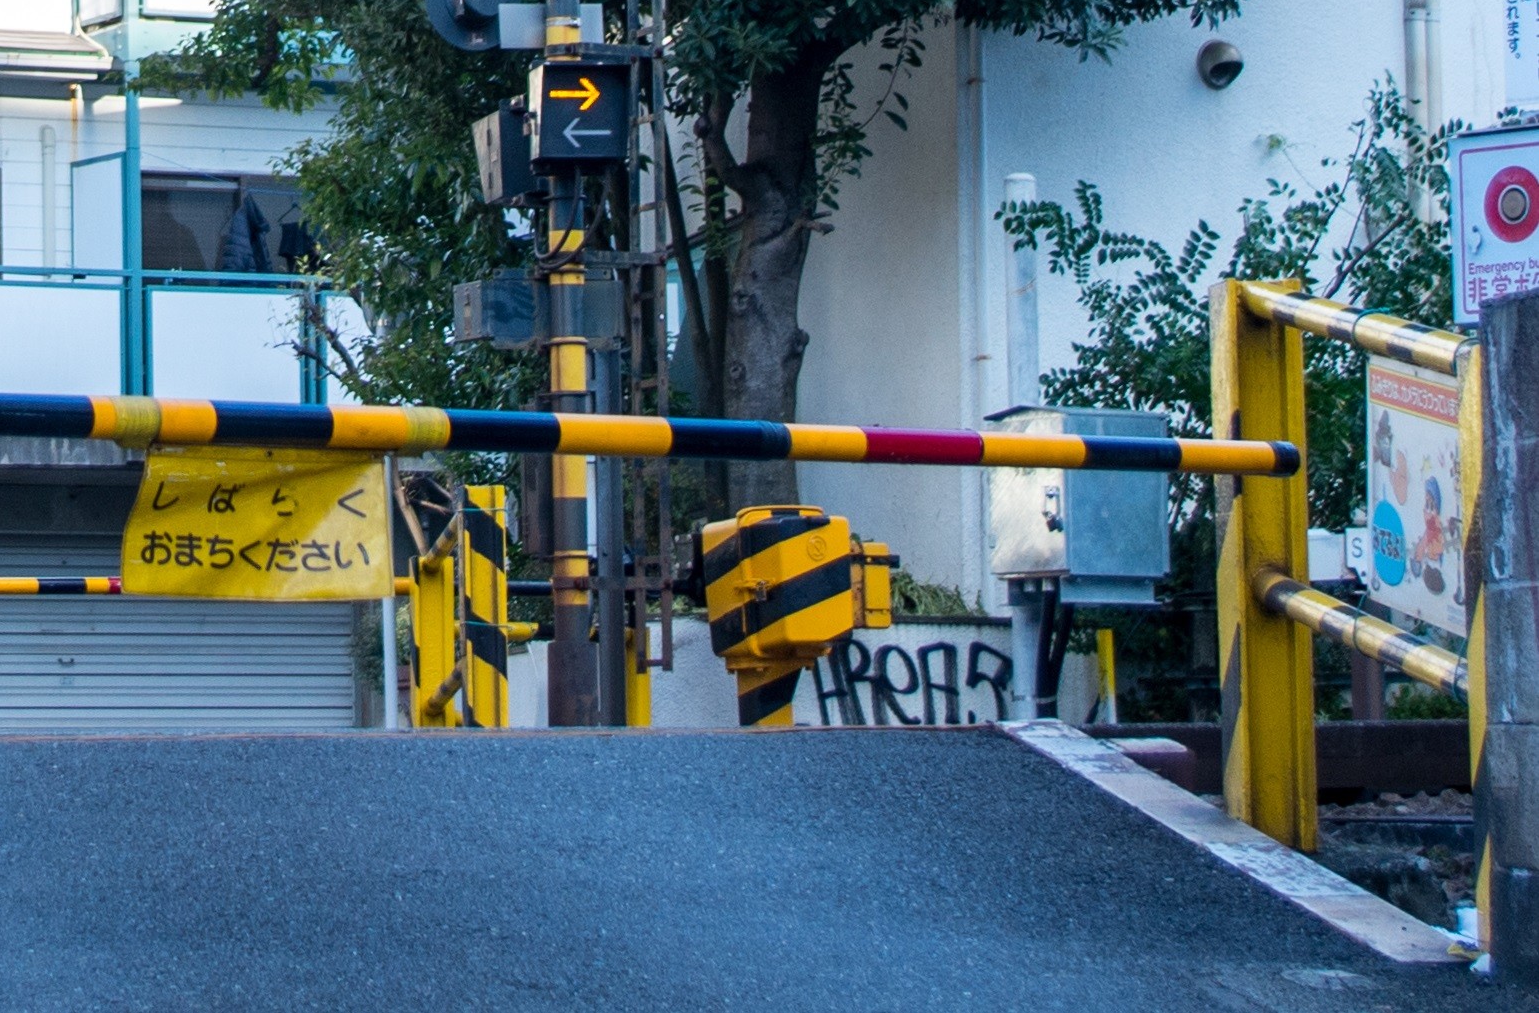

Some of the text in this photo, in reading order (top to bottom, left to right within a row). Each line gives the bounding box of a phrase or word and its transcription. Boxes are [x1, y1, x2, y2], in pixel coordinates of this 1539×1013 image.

[1468, 261, 1526, 275] Emergency
[152, 481, 367, 519] しばらく
[140, 531, 371, 572] おまちください
[1351, 536, 1363, 558] S
